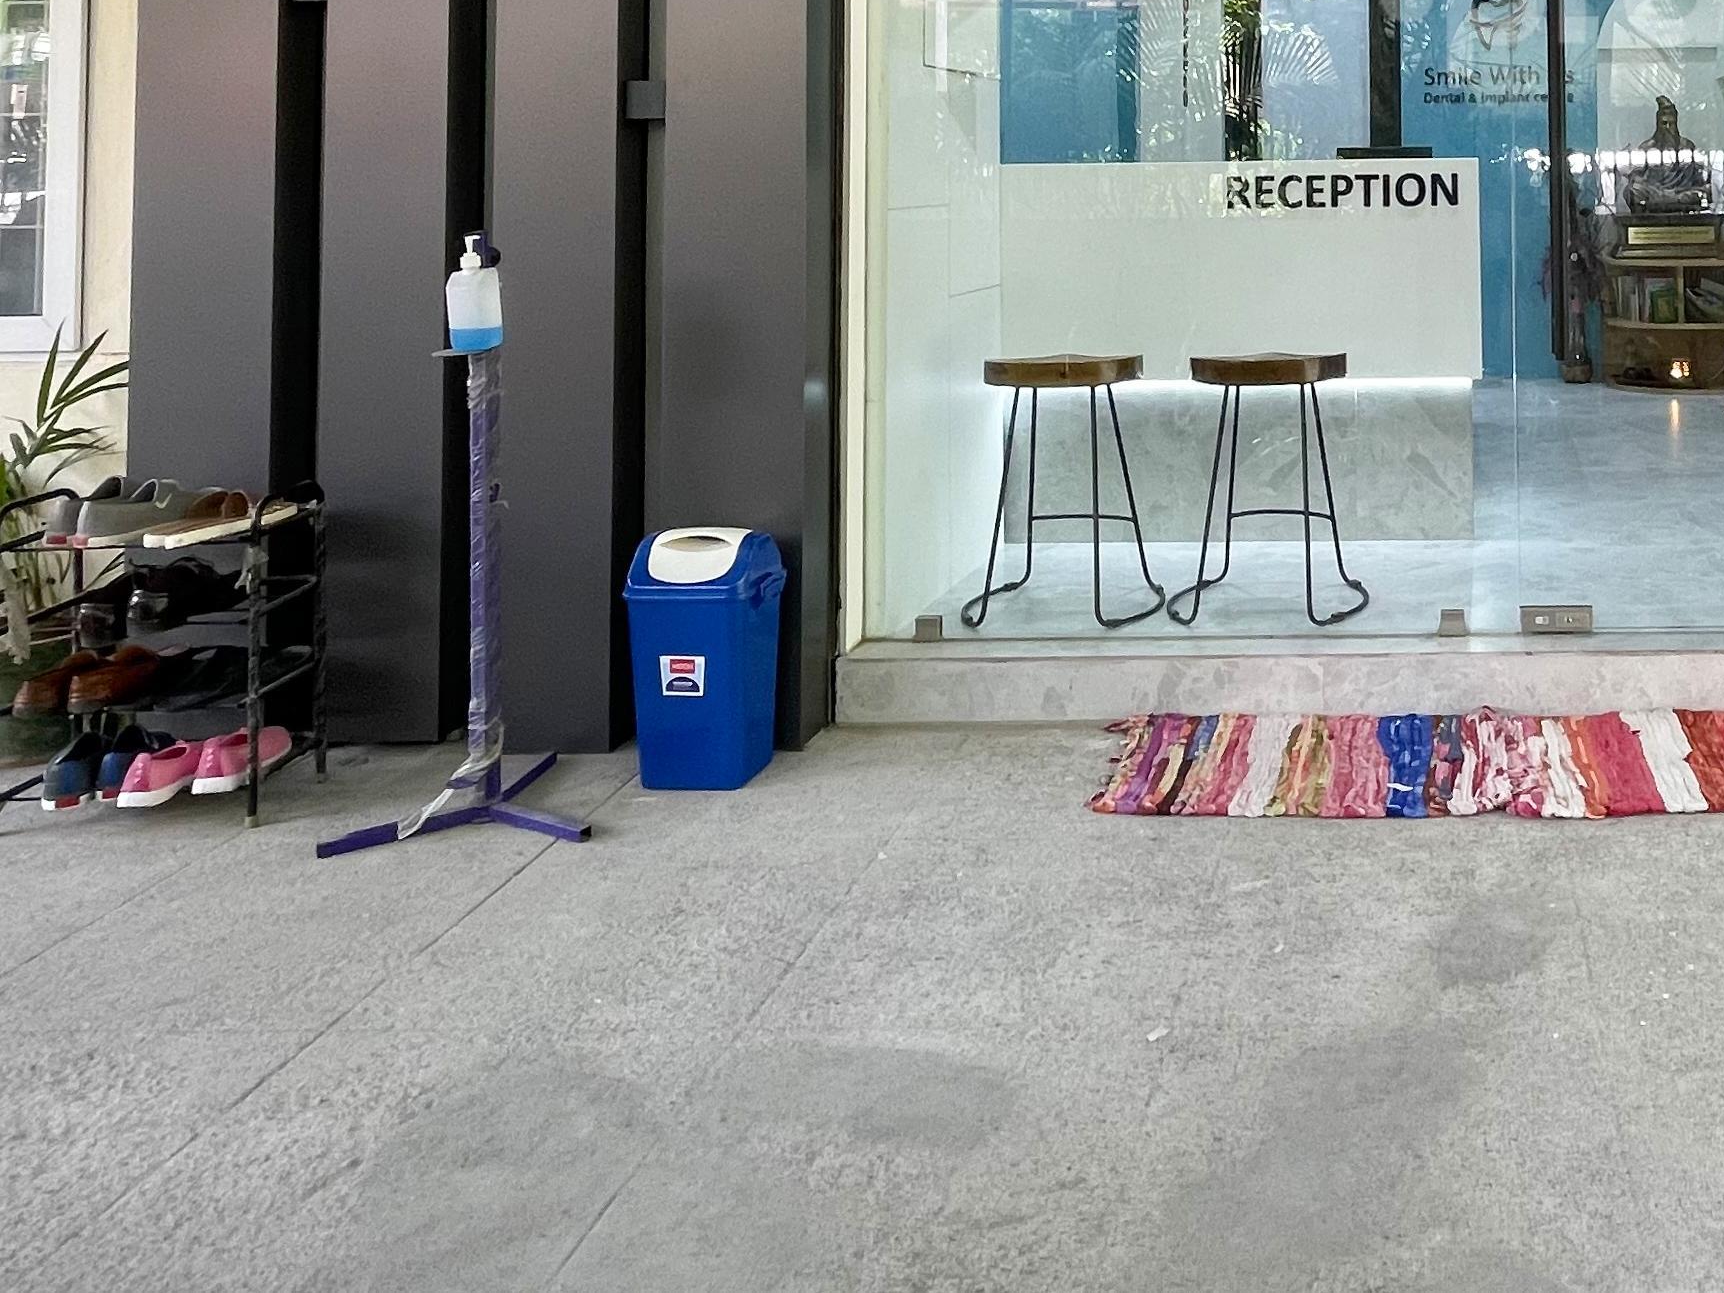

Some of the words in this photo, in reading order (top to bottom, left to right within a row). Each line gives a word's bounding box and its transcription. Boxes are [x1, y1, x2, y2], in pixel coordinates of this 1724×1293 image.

[1424, 67, 1482, 86] Smile
[1489, 65, 1540, 86] With
[1423, 91, 1465, 104] Dental
[1226, 172, 1460, 210] RECEPTION
